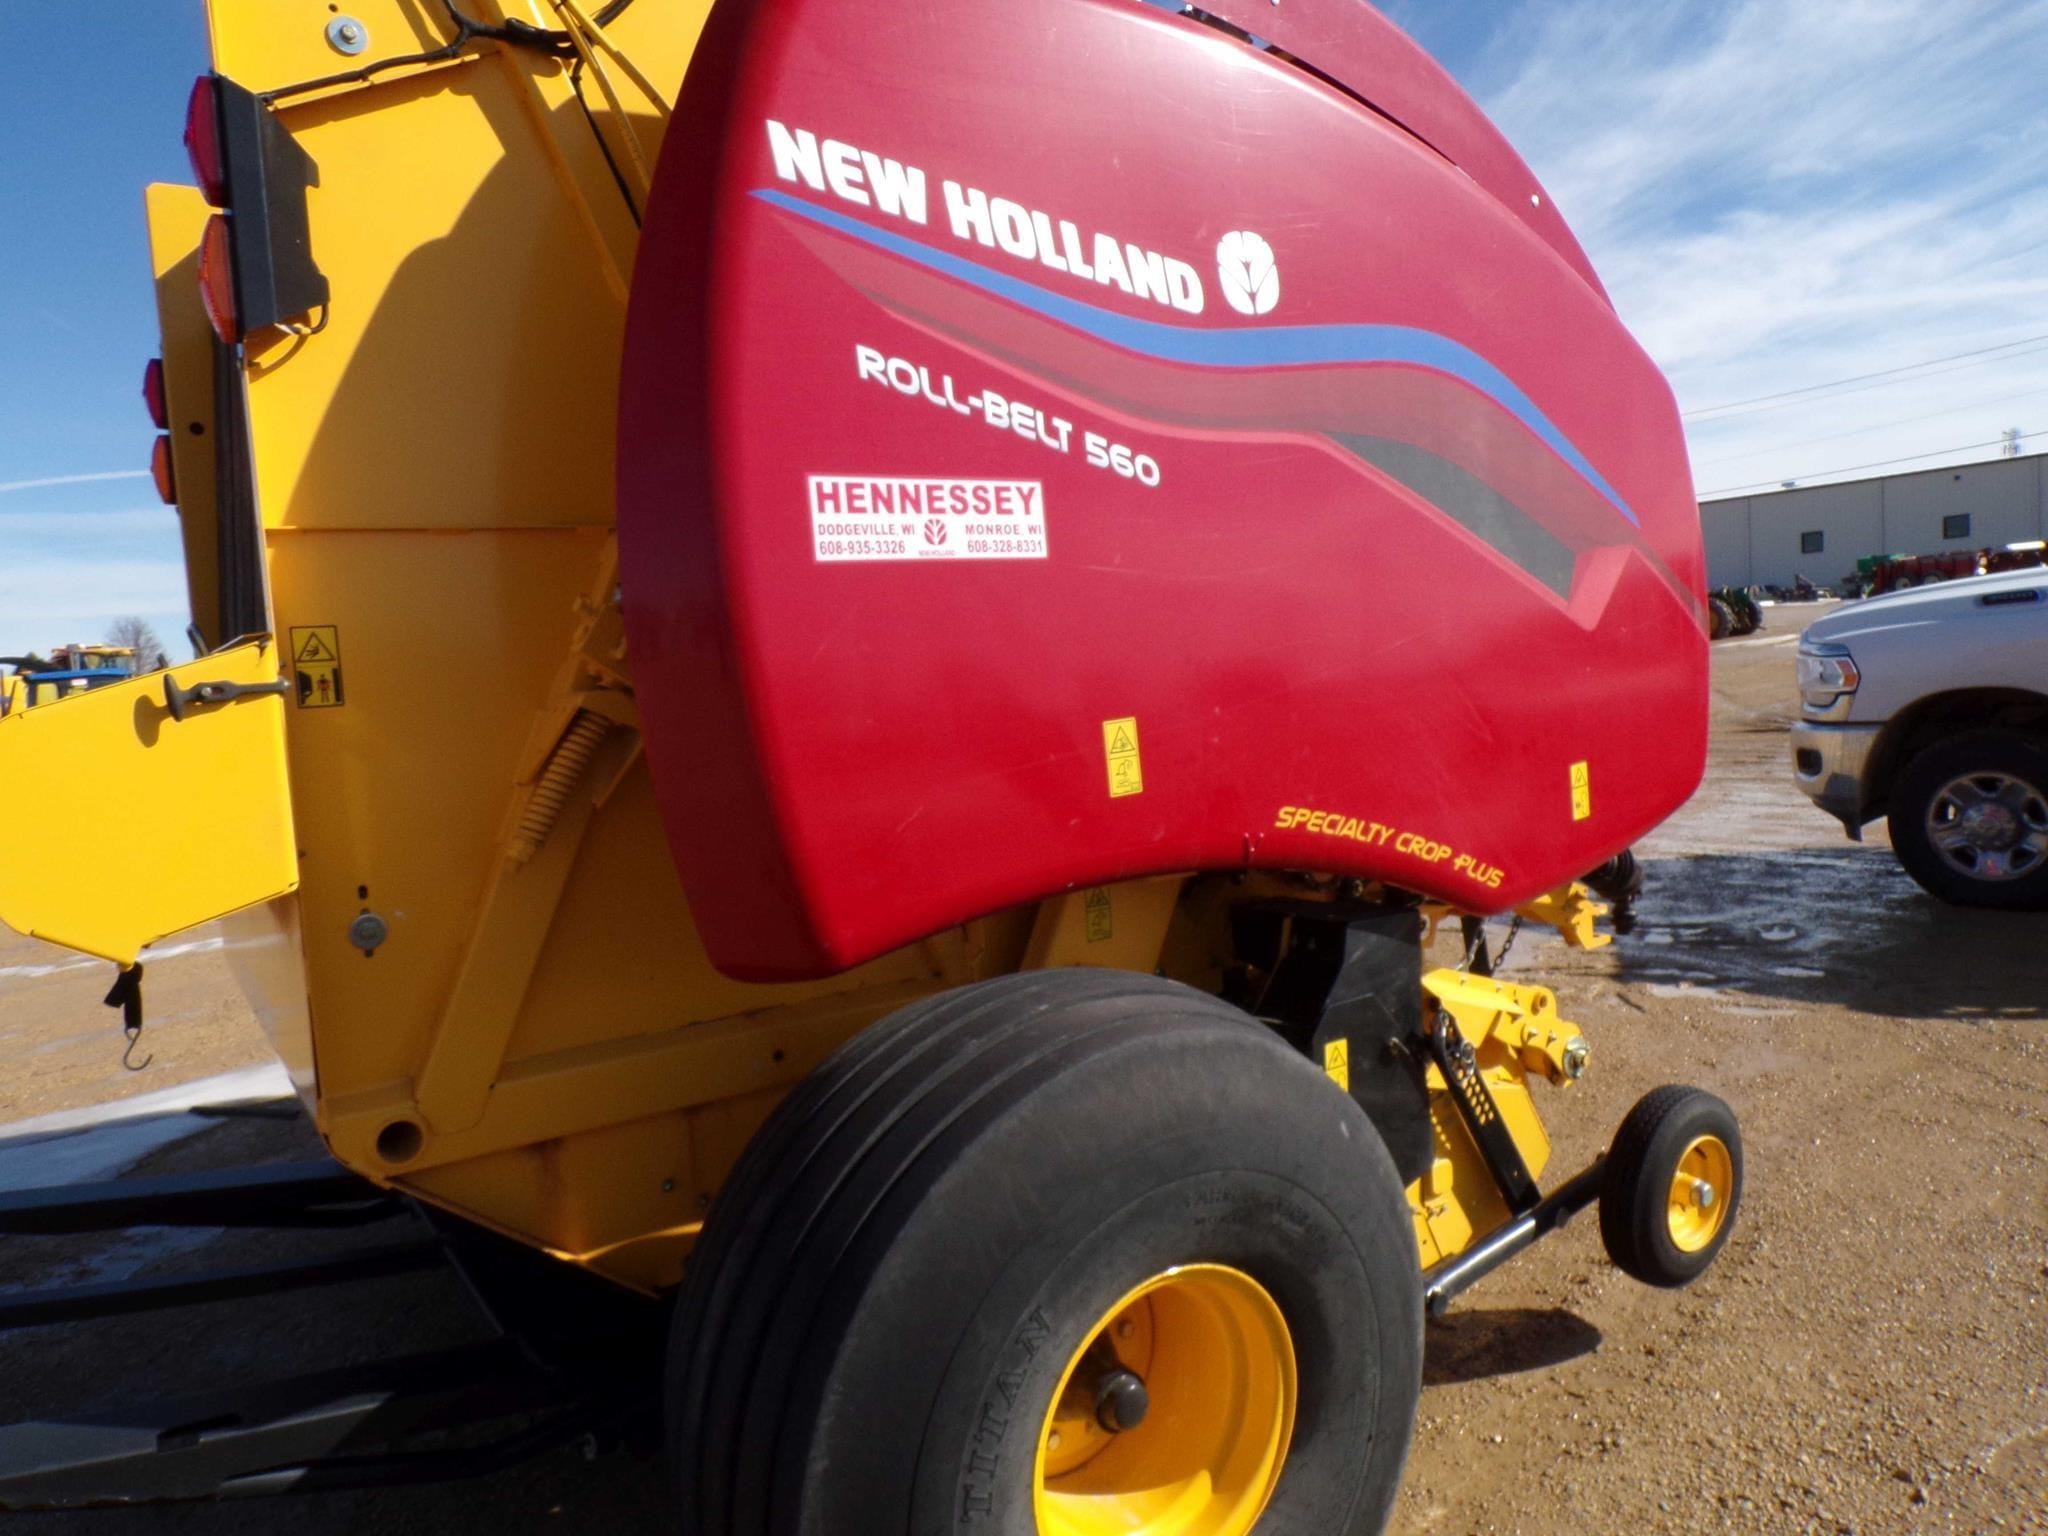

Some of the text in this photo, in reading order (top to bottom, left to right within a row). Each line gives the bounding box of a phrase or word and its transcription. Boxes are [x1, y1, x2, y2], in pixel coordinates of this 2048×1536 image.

[765, 119, 1204, 315] NEW HOLLAND
[856, 344, 1160, 488] ROLL-BELT 560
[815, 481, 1036, 515] HENNESSEY
[902, 524, 915, 535] WI
[967, 539, 1043, 553] 608-328-8331
[1028, 525, 1042, 535] WI
[819, 540, 906, 555] 608-935-3326
[1275, 806, 1504, 888] SPECIALTY CROP PLUS
[962, 1308, 1051, 1523] TITAN
